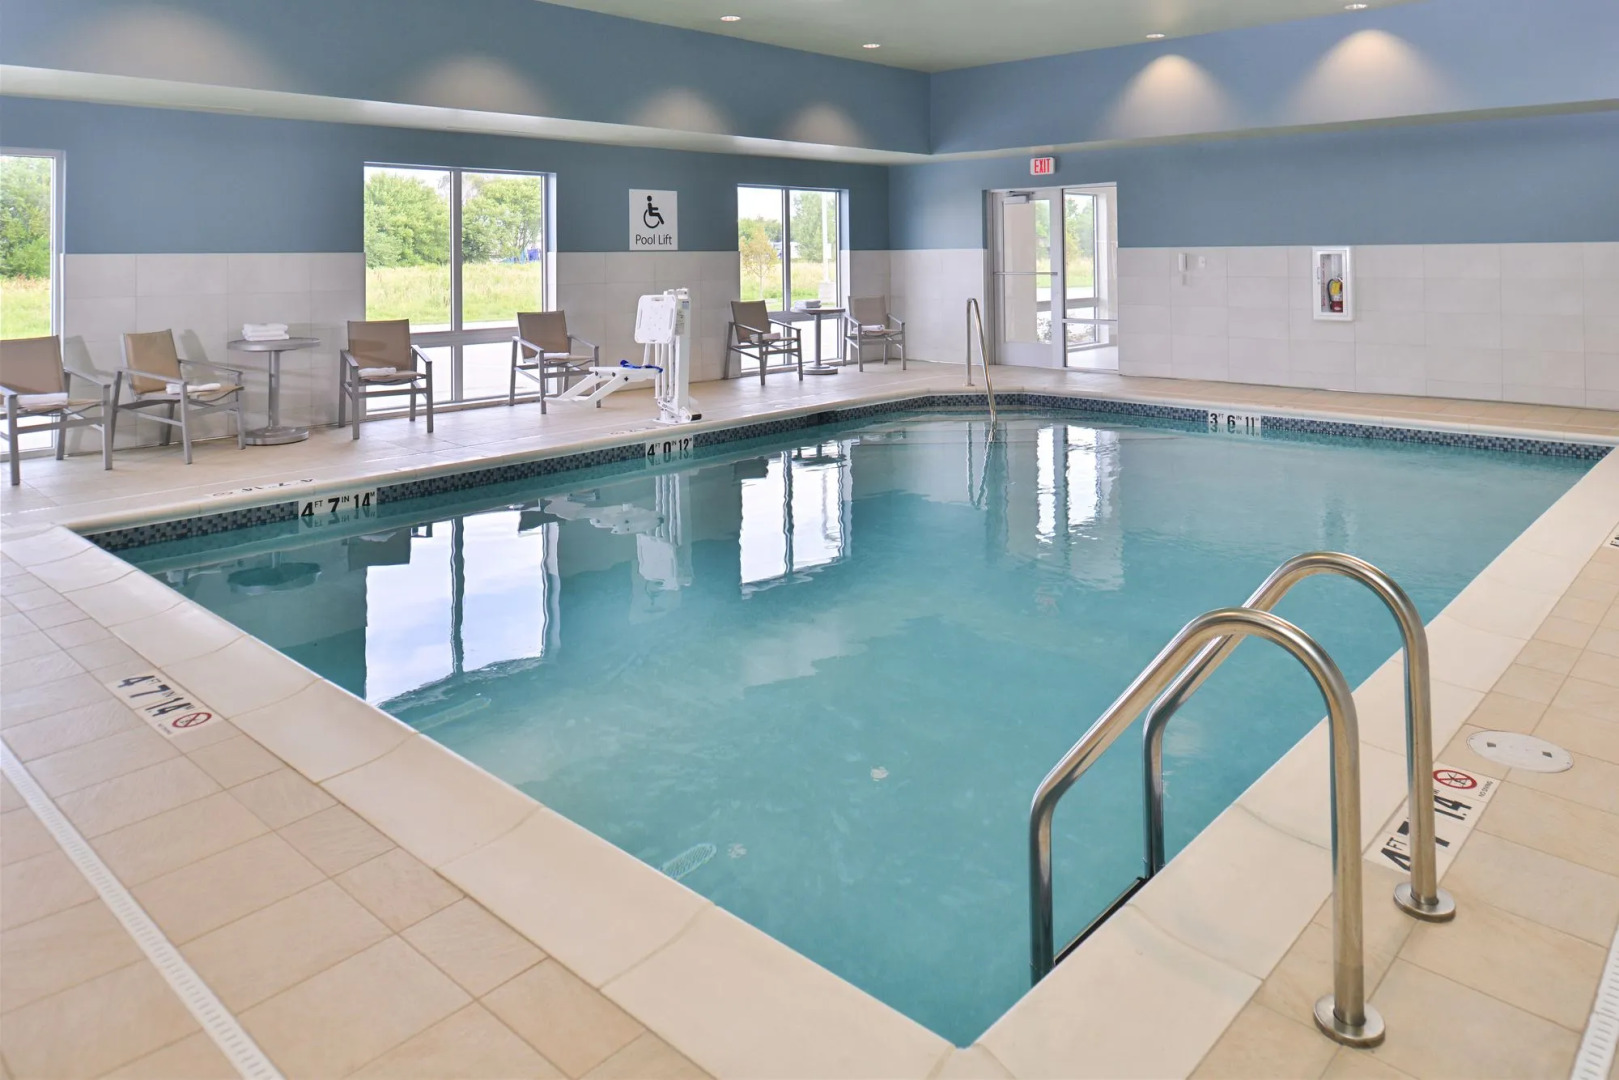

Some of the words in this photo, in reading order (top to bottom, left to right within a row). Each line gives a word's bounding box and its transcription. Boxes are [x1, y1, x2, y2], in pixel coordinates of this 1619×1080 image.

[1034, 158, 1050, 173] EXIT
[636, 234, 655, 245] Pool
[658, 234, 672, 245] Lift
[1210, 413, 1218, 424] 3
[1227, 415, 1236, 426] 6
[647, 444, 655, 455] 4
[663, 441, 671, 453] 0
[301, 502, 314, 517] 4
[328, 497, 340, 512] 7
[118, 675, 155, 688] 4
[129, 684, 171, 698] 7
[1483, 780, 1494, 793] DIVING
[1386, 837, 1407, 851] FT
